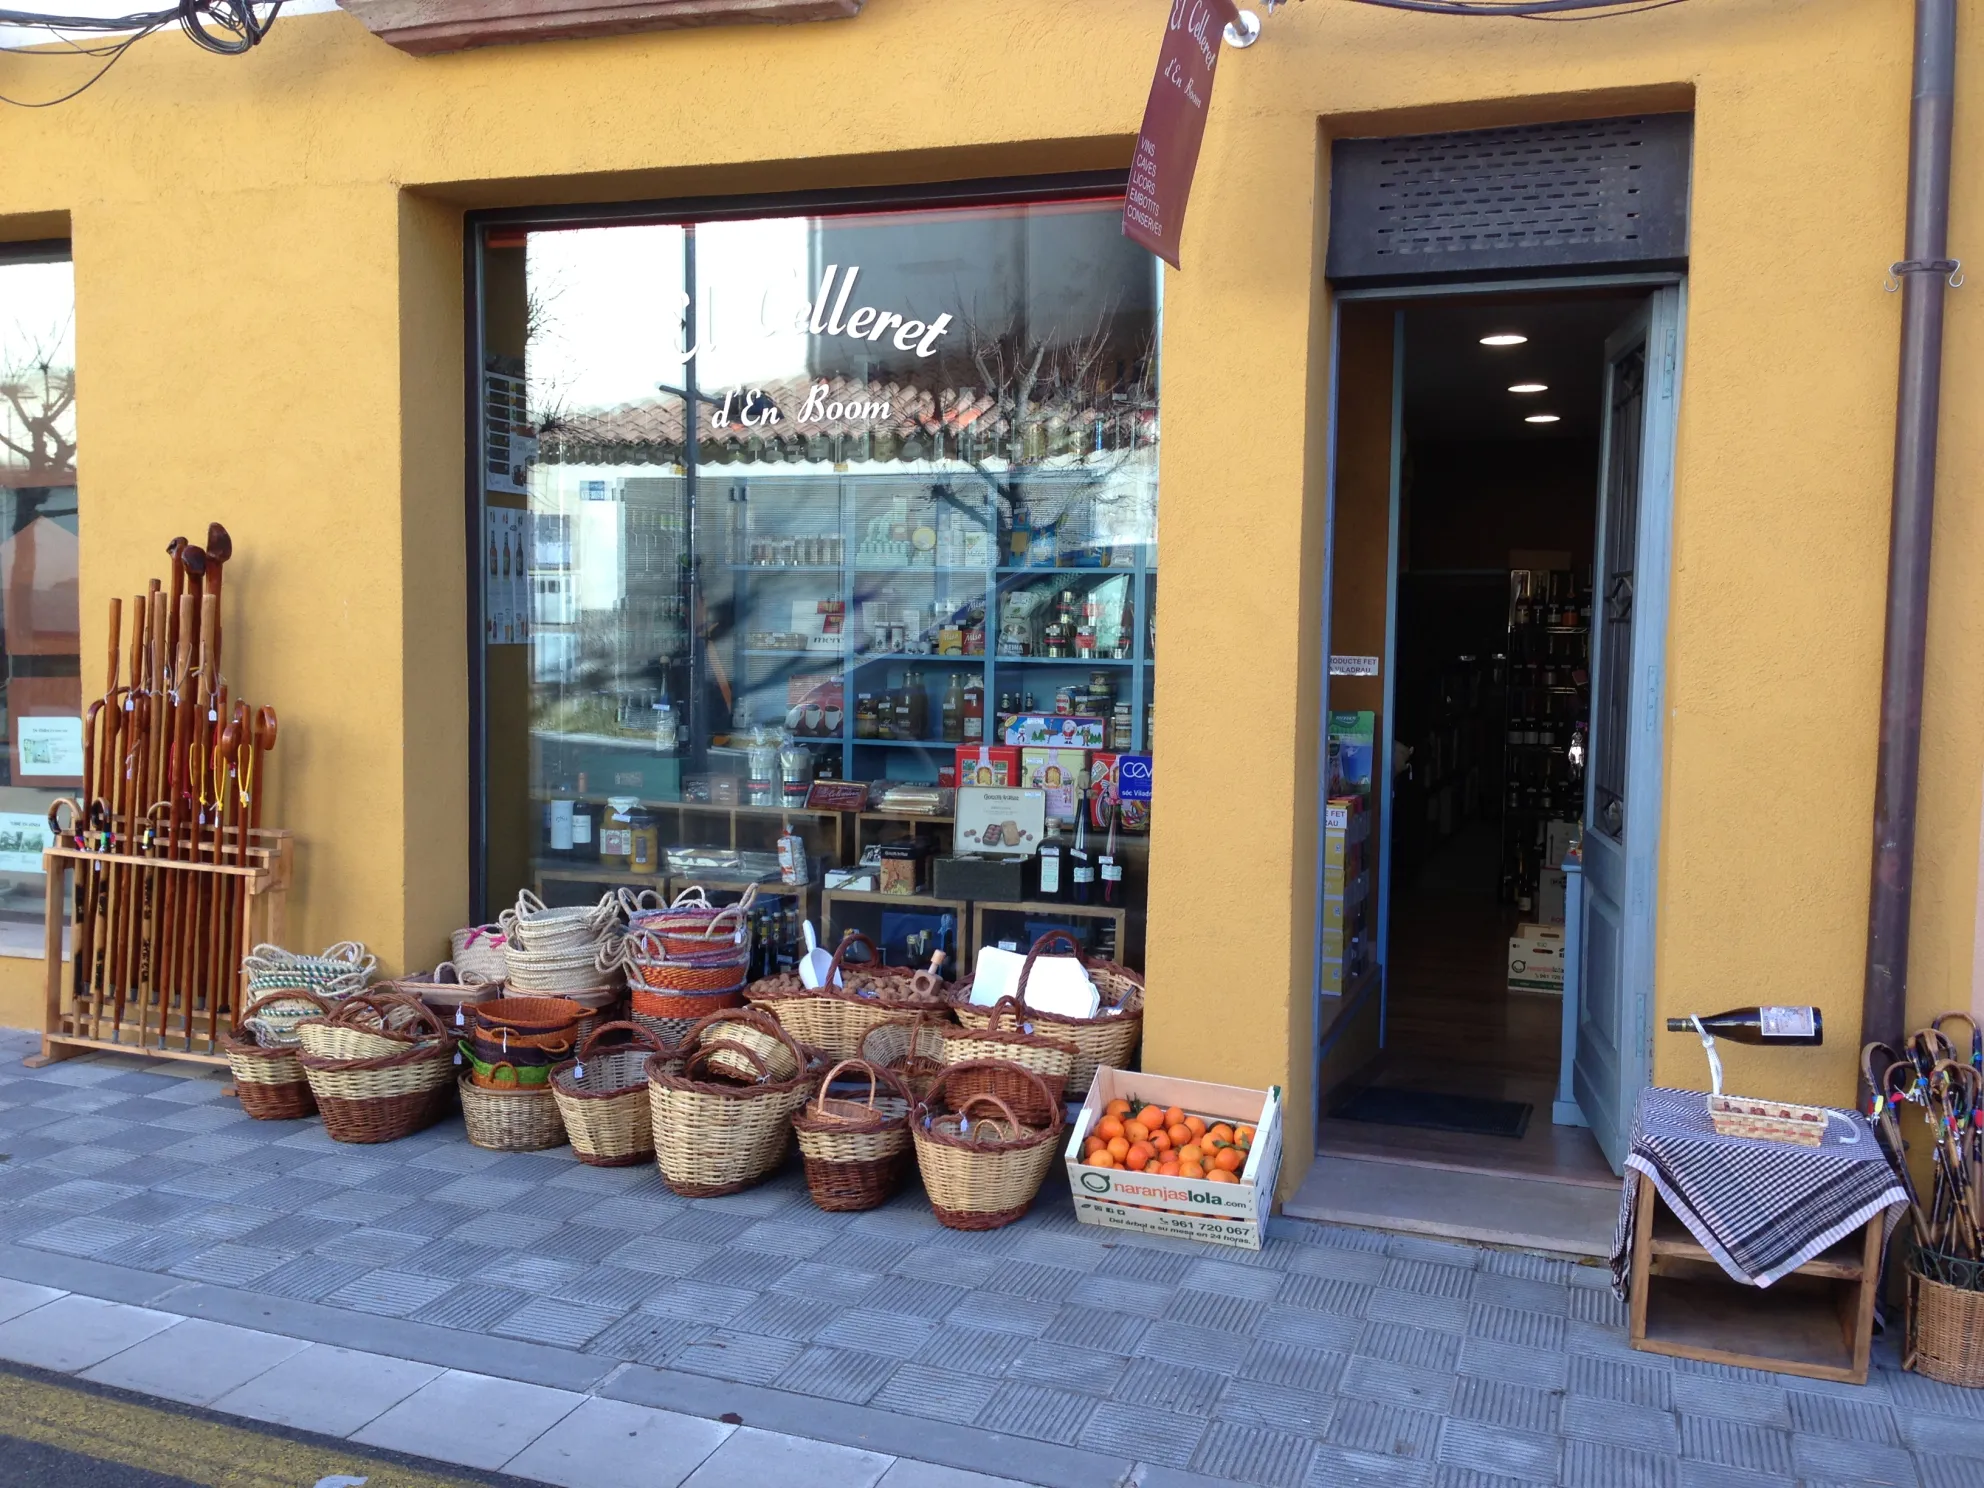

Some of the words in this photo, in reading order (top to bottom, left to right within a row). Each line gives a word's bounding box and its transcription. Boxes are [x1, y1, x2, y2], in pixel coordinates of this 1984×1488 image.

[1188, 0, 1216, 71] Celleret
[1141, 136, 1156, 157] VINS
[1136, 154, 1157, 177] CAVES
[1132, 170, 1156, 195] LICORS
[1129, 187, 1160, 216] EMBOTITS
[1127, 204, 1162, 236] CONSERVES
[711, 384, 780, 429] d'En
[797, 383, 892, 423] Boom
[1330, 810, 1346, 818] FET
[1126, 1219, 1148, 1228] árbol
[1223, 1234, 1252, 1245] horas.
[1171, 1219, 1194, 1229] 961
[1198, 1223, 1223, 1233] 720
[1226, 1226, 1250, 1236] 067
